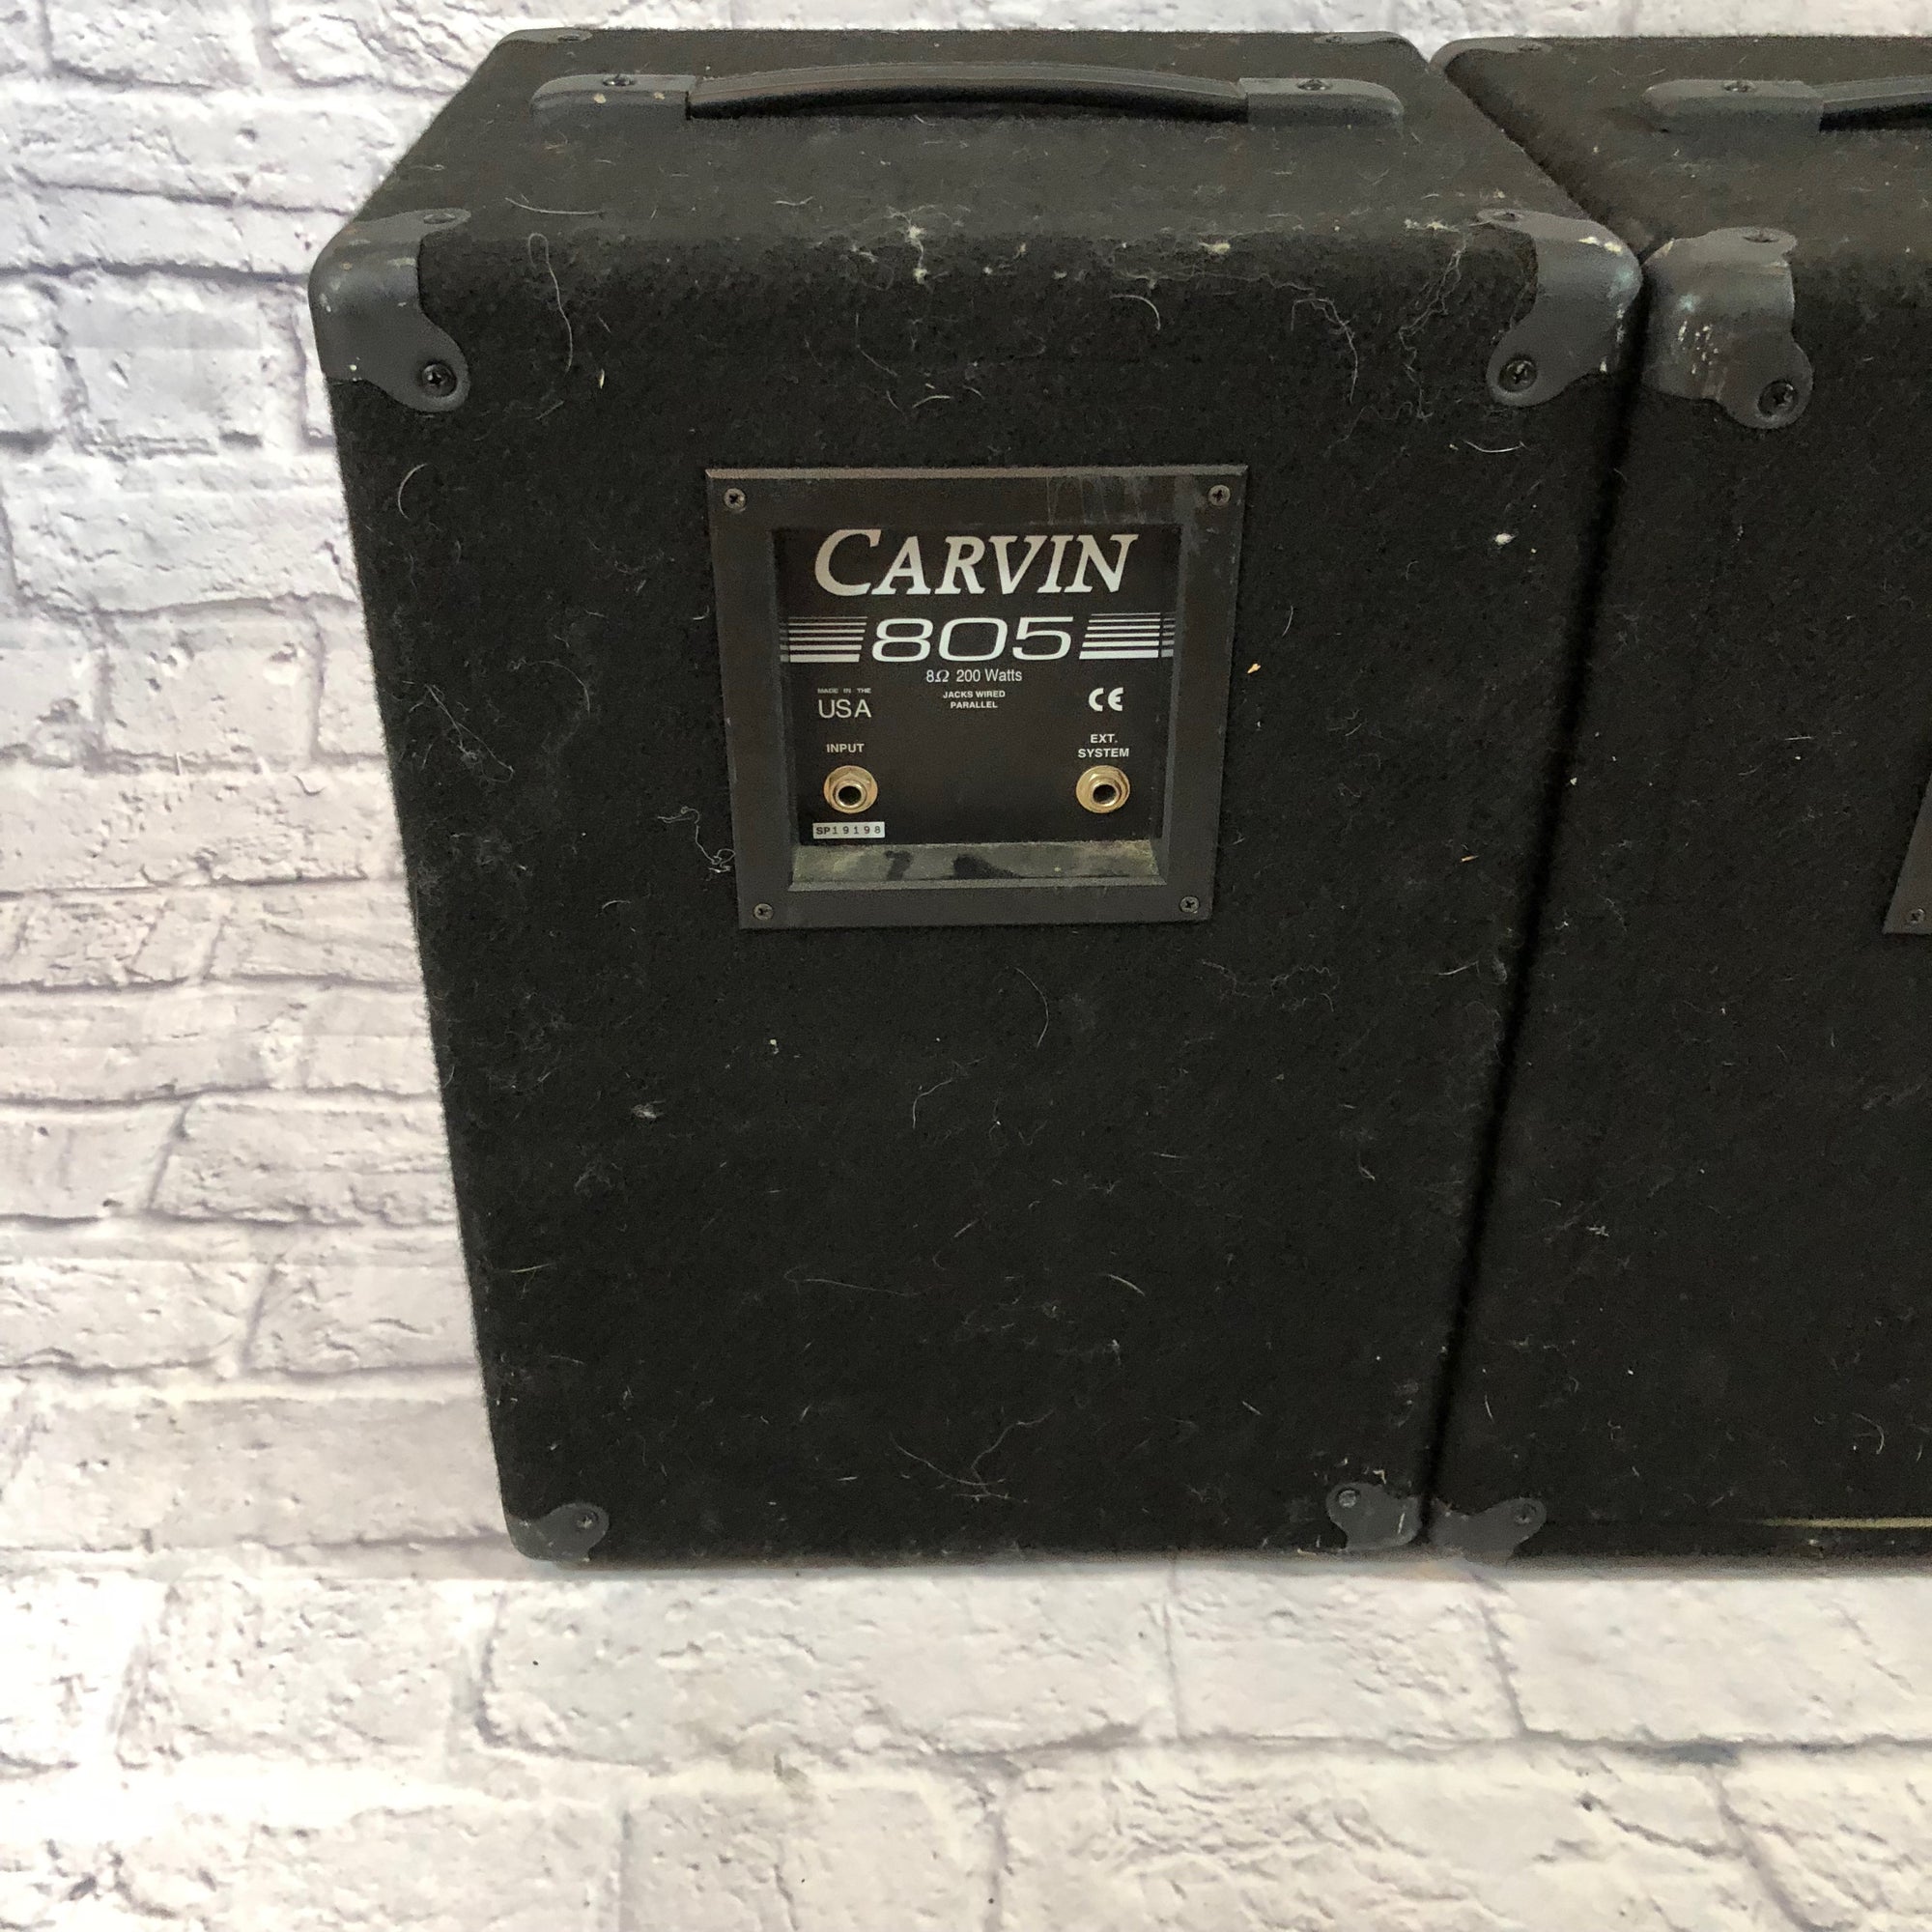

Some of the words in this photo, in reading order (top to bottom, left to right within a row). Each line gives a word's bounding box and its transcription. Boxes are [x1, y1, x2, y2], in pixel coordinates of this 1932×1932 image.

[814, 528, 1139, 596] CARVIN
[871, 615, 1074, 663] 805
[955, 668, 980, 683] 200
[984, 668, 1023, 683] Watts
[942, 690, 973, 699] JACKS
[976, 689, 1006, 698] WIRED
[817, 698, 872, 719] USA
[950, 700, 998, 709] PARALLEL
[1090, 733, 1119, 744] EXT.
[826, 743, 865, 753] INPUT
[1077, 747, 1130, 758] SYSTEM
